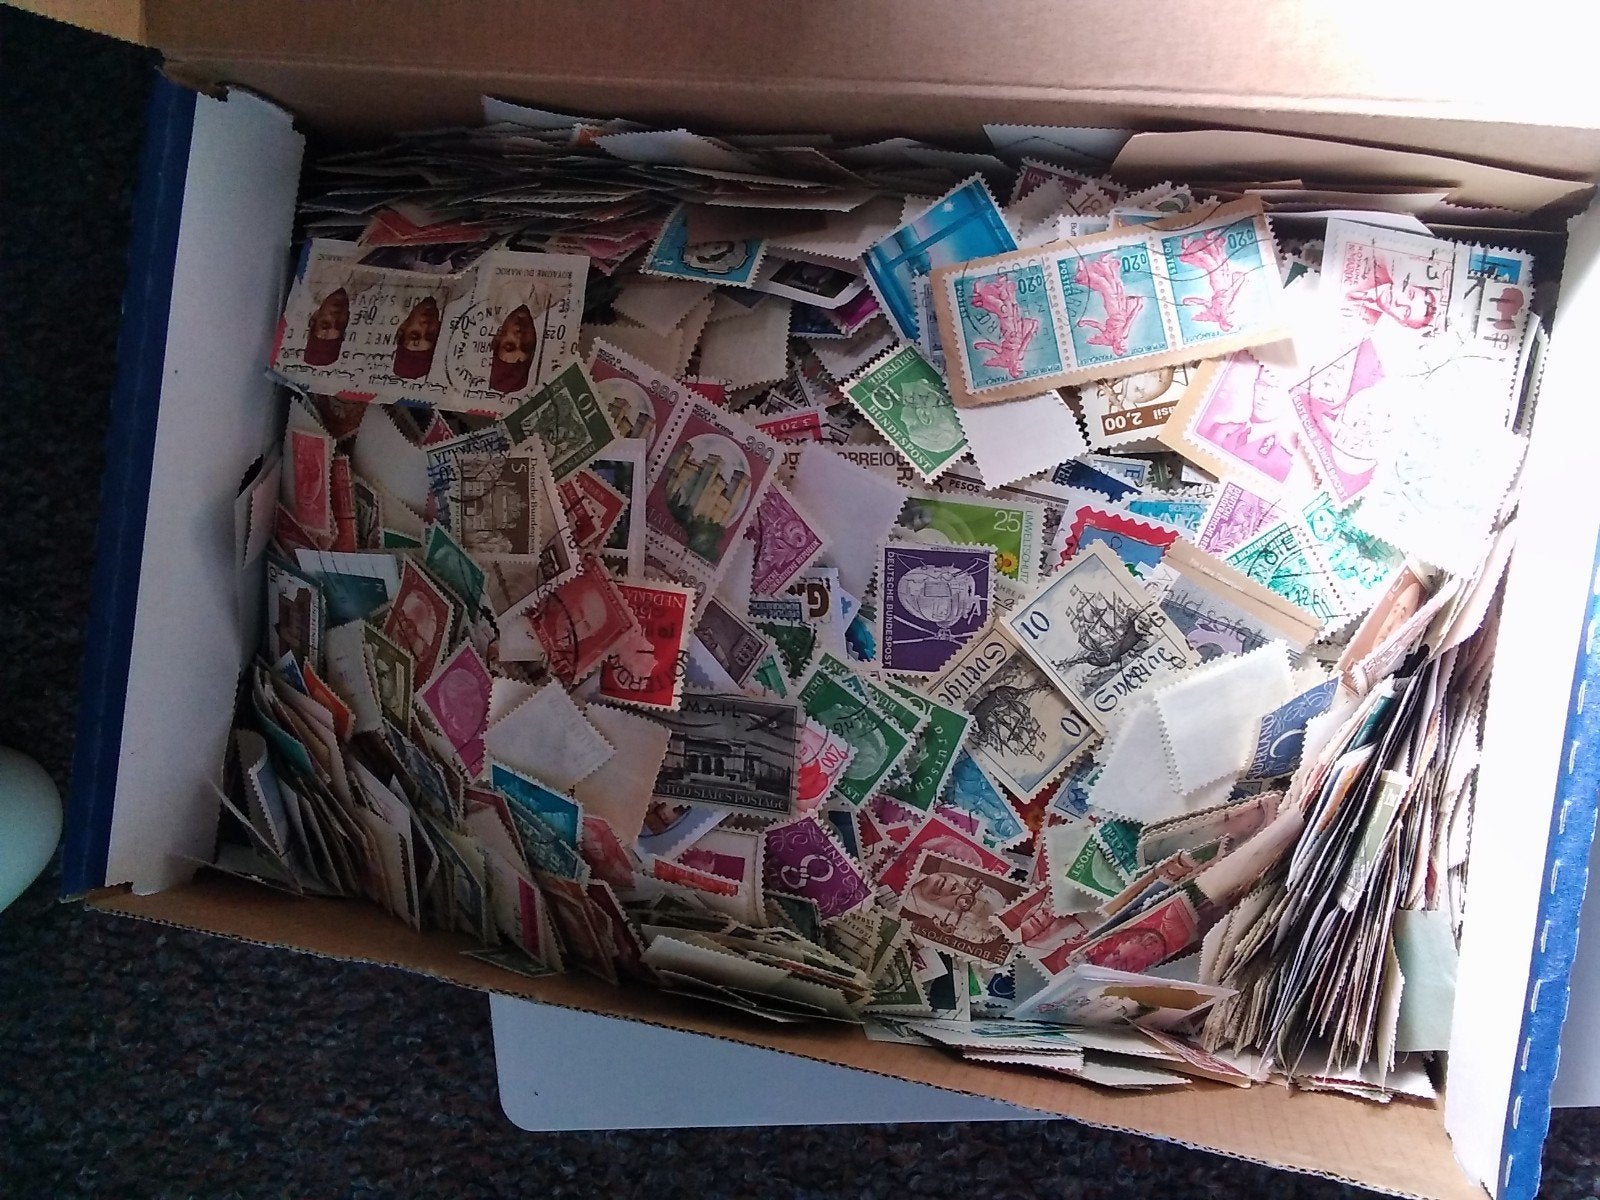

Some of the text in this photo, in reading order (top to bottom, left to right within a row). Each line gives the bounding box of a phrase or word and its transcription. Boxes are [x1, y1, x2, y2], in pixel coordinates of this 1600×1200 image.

[495, 267, 522, 276] MAROC
[537, 269, 572, 279] ROYAUME
[1163, 242, 1177, 276] POSTES
[1060, 260, 1071, 296] POSTES
[955, 284, 967, 318] POSTES
[867, 351, 915, 387] DEUTSCHE
[578, 392, 598, 420] 10
[650, 378, 679, 406] 380
[870, 382, 903, 412] 10
[1104, 411, 1143, 432] 2,00
[1152, 405, 1176, 421] asil
[744, 435, 775, 464] 380
[866, 402, 934, 471] BUNDESPOST
[511, 462, 527, 474] 5
[949, 479, 980, 493] PESOS
[528, 457, 538, 554] Deutsche Bundespost
[1207, 483, 1235, 537] DEMOKRATISCHE
[1221, 487, 1242, 520] DEUTSCHE
[993, 510, 1021, 533] 25
[795, 540, 820, 565] REPUBLIK
[1021, 510, 1033, 584] UMWELTSCHUTZ
[750, 602, 800, 610] DEMOKRATISCH
[884, 551, 896, 667] DEUTSCHE BUNDESPOST
[1019, 610, 1050, 640] 10
[937, 640, 1008, 707] Sverige
[1093, 646, 1173, 714] Sverige
[684, 701, 741, 719] MAIL
[692, 788, 733, 802] STATES
[733, 795, 786, 811] POSTAGE
[824, 844, 850, 874] CENT
